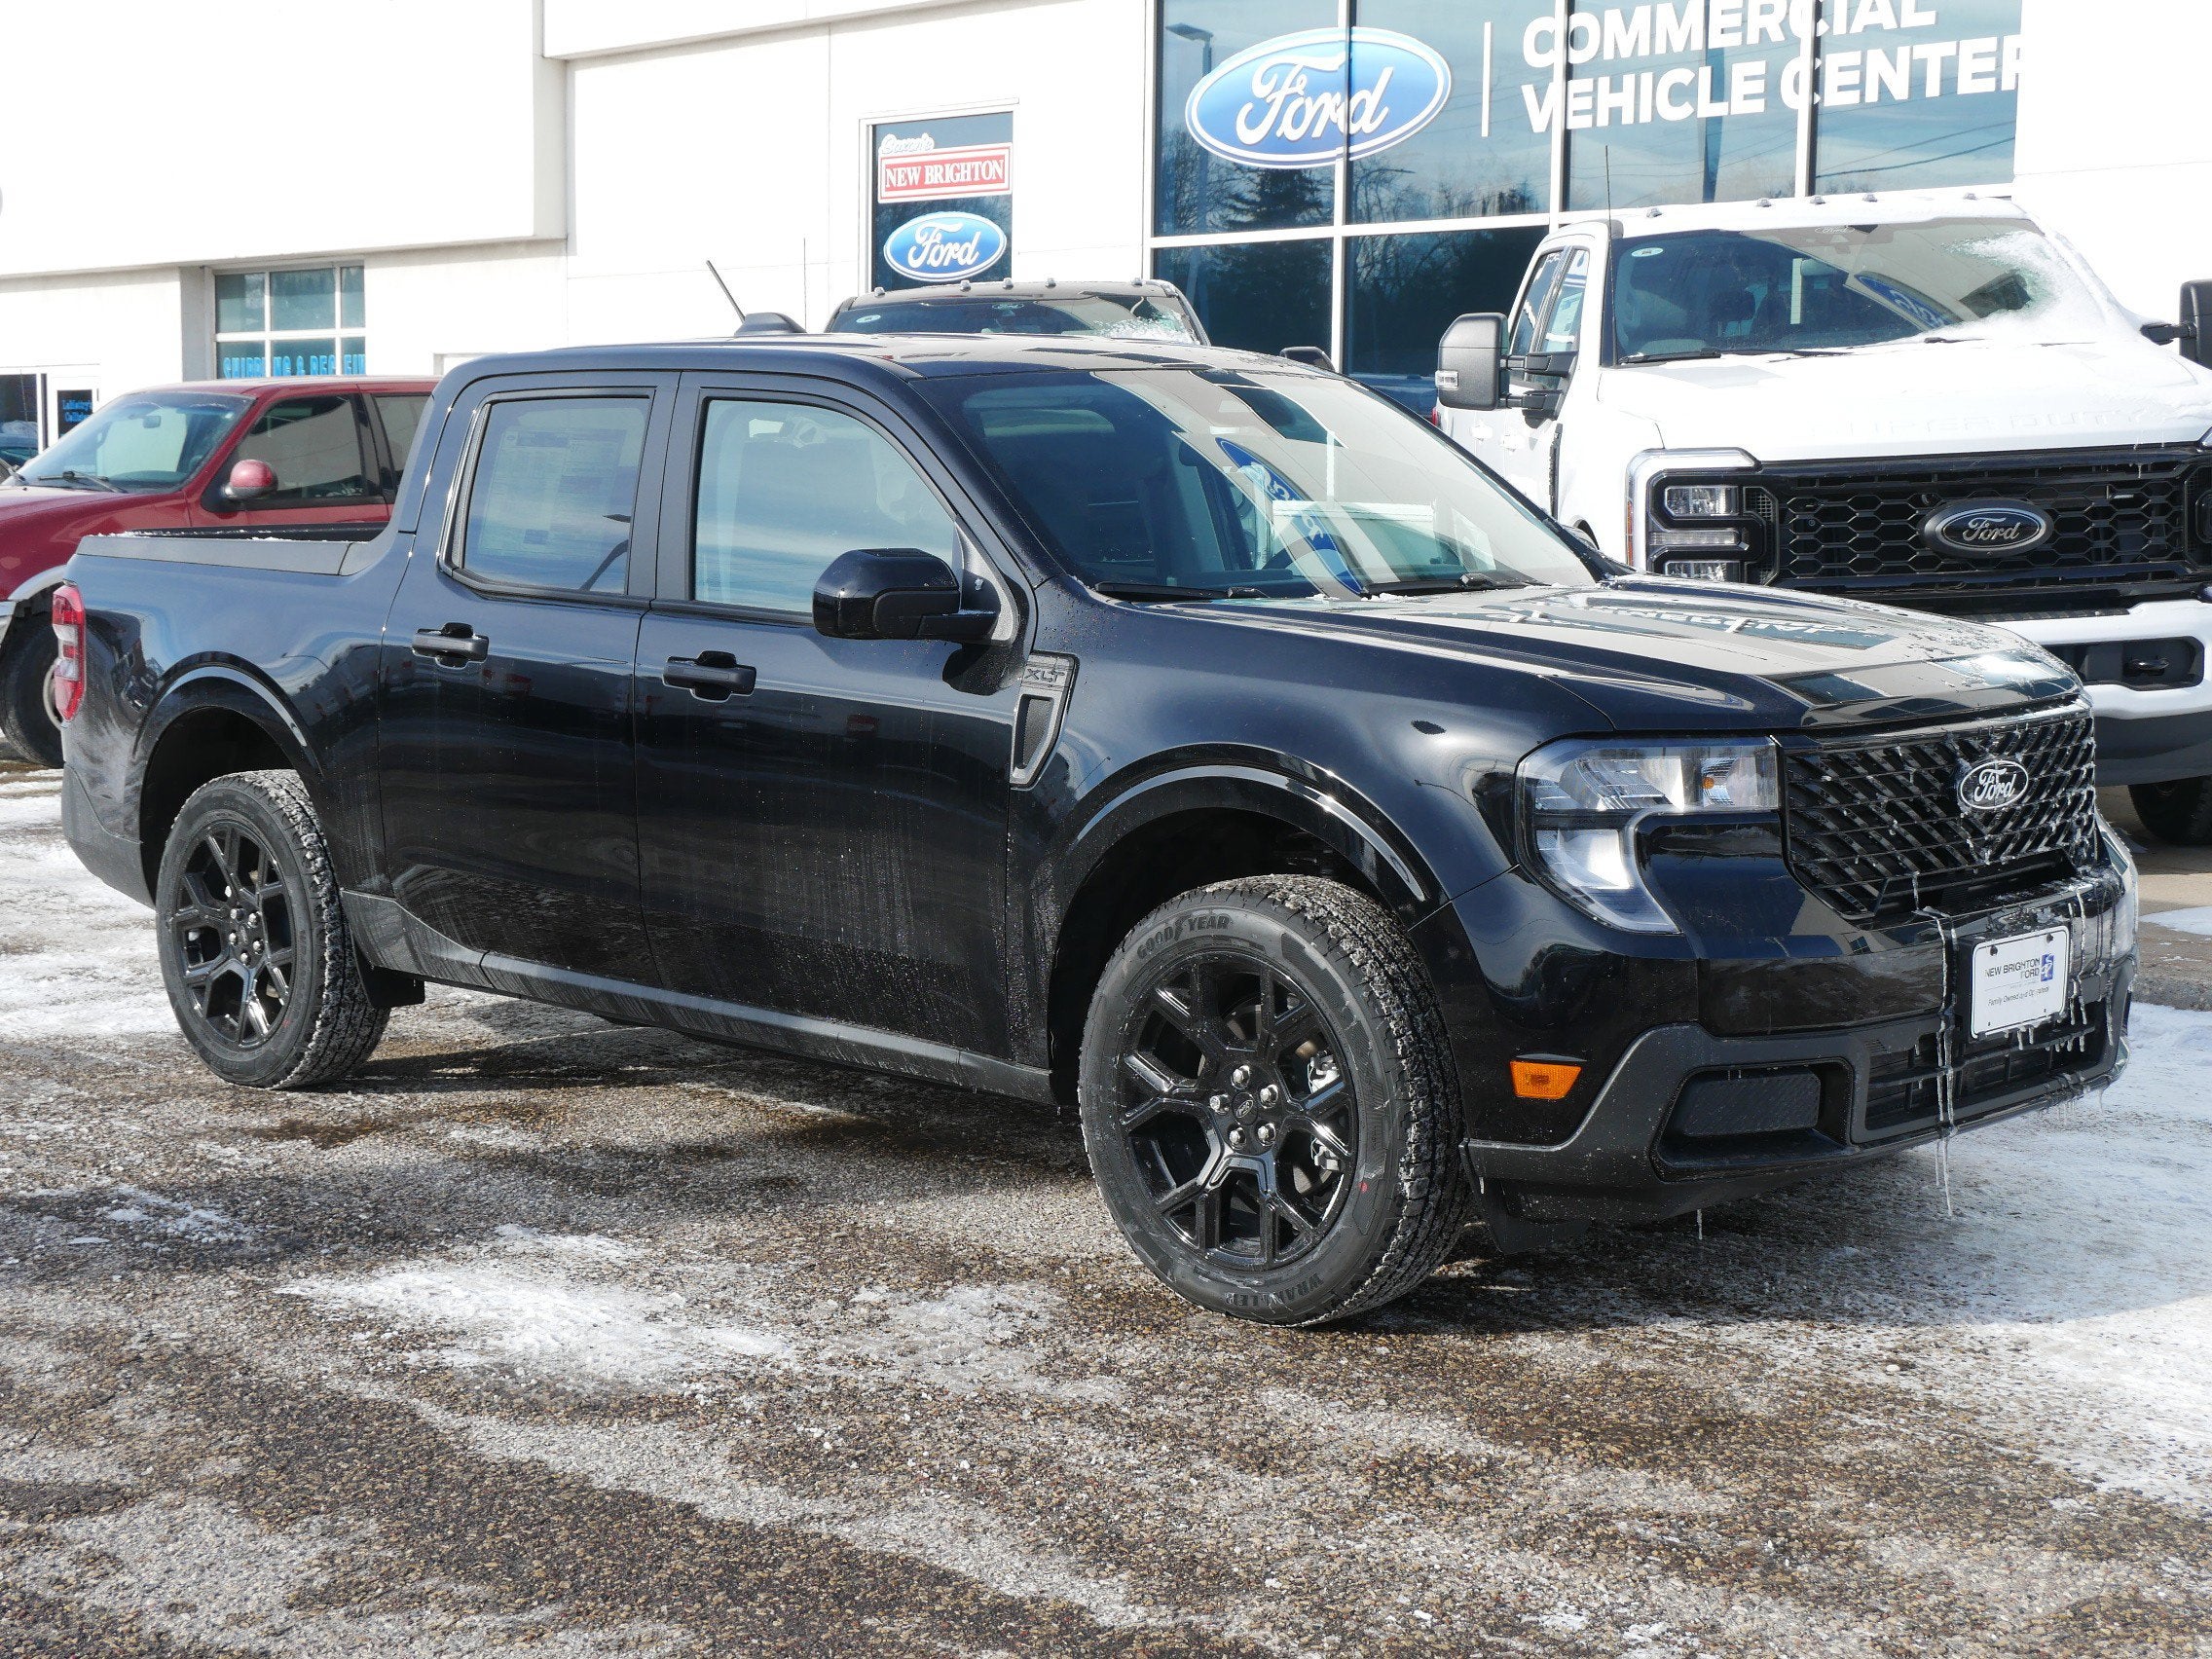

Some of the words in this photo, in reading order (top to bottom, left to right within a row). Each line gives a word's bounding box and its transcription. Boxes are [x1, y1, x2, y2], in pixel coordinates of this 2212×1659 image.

[1523, 0, 1936, 68] COMMERCIAL
[1235, 50, 1394, 145] Ford
[1521, 60, 1766, 132] VEHICLE
[885, 166, 921, 188] NEW
[924, 159, 1005, 185] BRIGHTON
[907, 222, 981, 268] Ford
[1962, 517, 2021, 541] Ford
[1024, 668, 1066, 683] XLT
[1973, 768, 2017, 802] Ford
[1985, 966, 2002, 977] NEW
[2003, 958, 2041, 974] BRIGHTON
[2020, 967, 2041, 978] FORD
